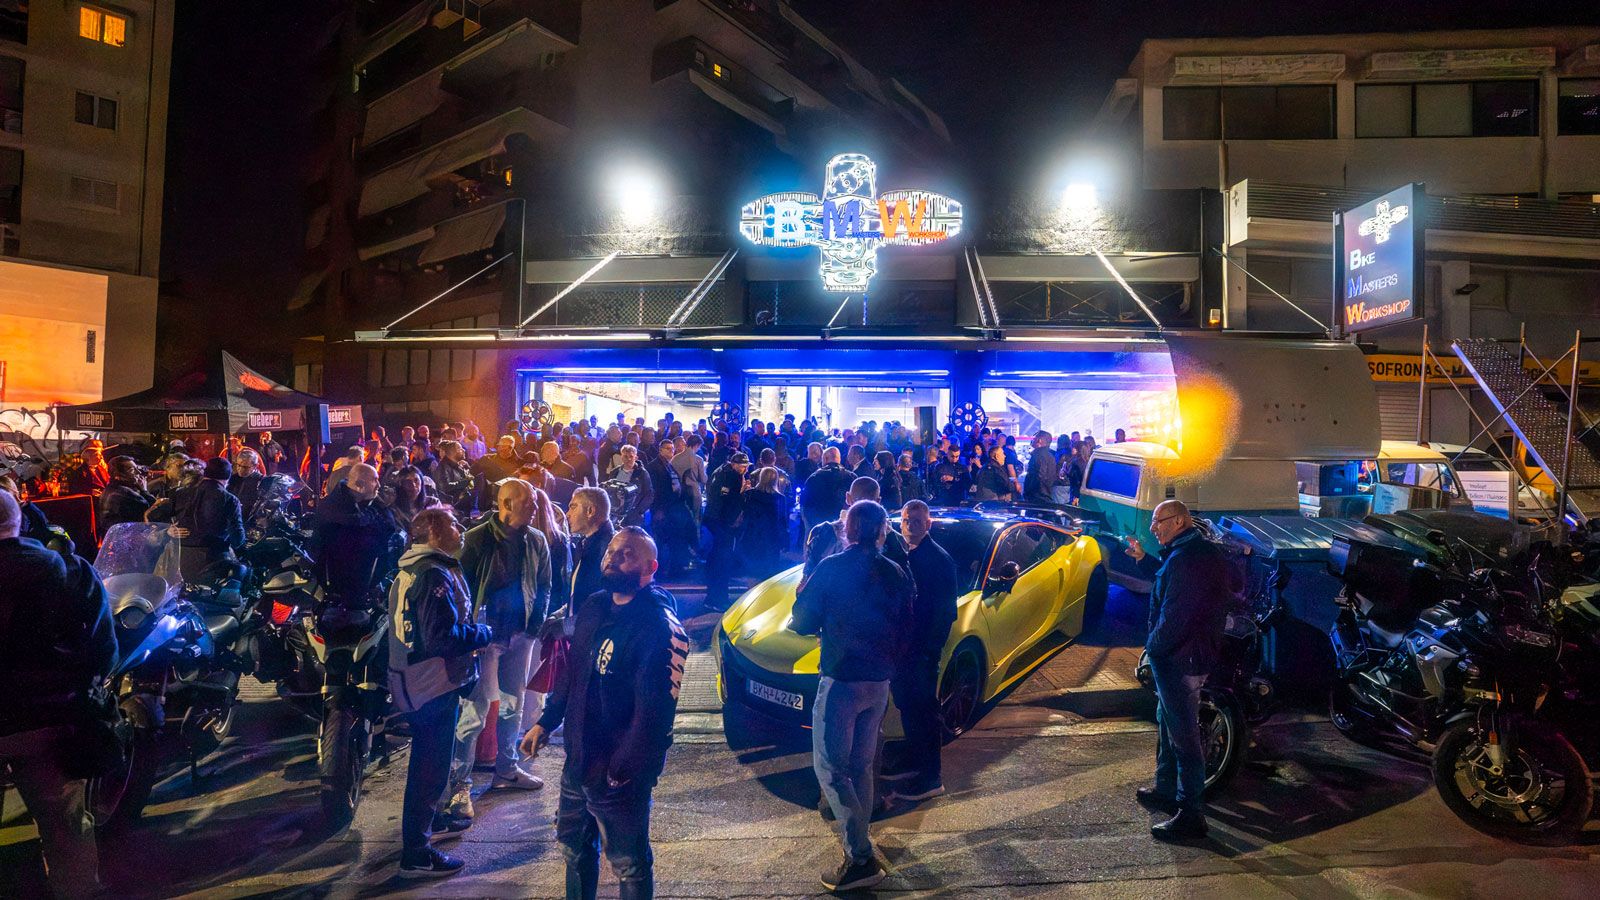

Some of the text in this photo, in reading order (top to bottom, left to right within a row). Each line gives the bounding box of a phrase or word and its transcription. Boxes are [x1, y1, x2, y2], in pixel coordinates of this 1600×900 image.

[909, 231, 945, 239] WORKSHOP
[80, 411, 105, 426] weber
[171, 412, 198, 428] weber
[249, 412, 273, 427] weber
